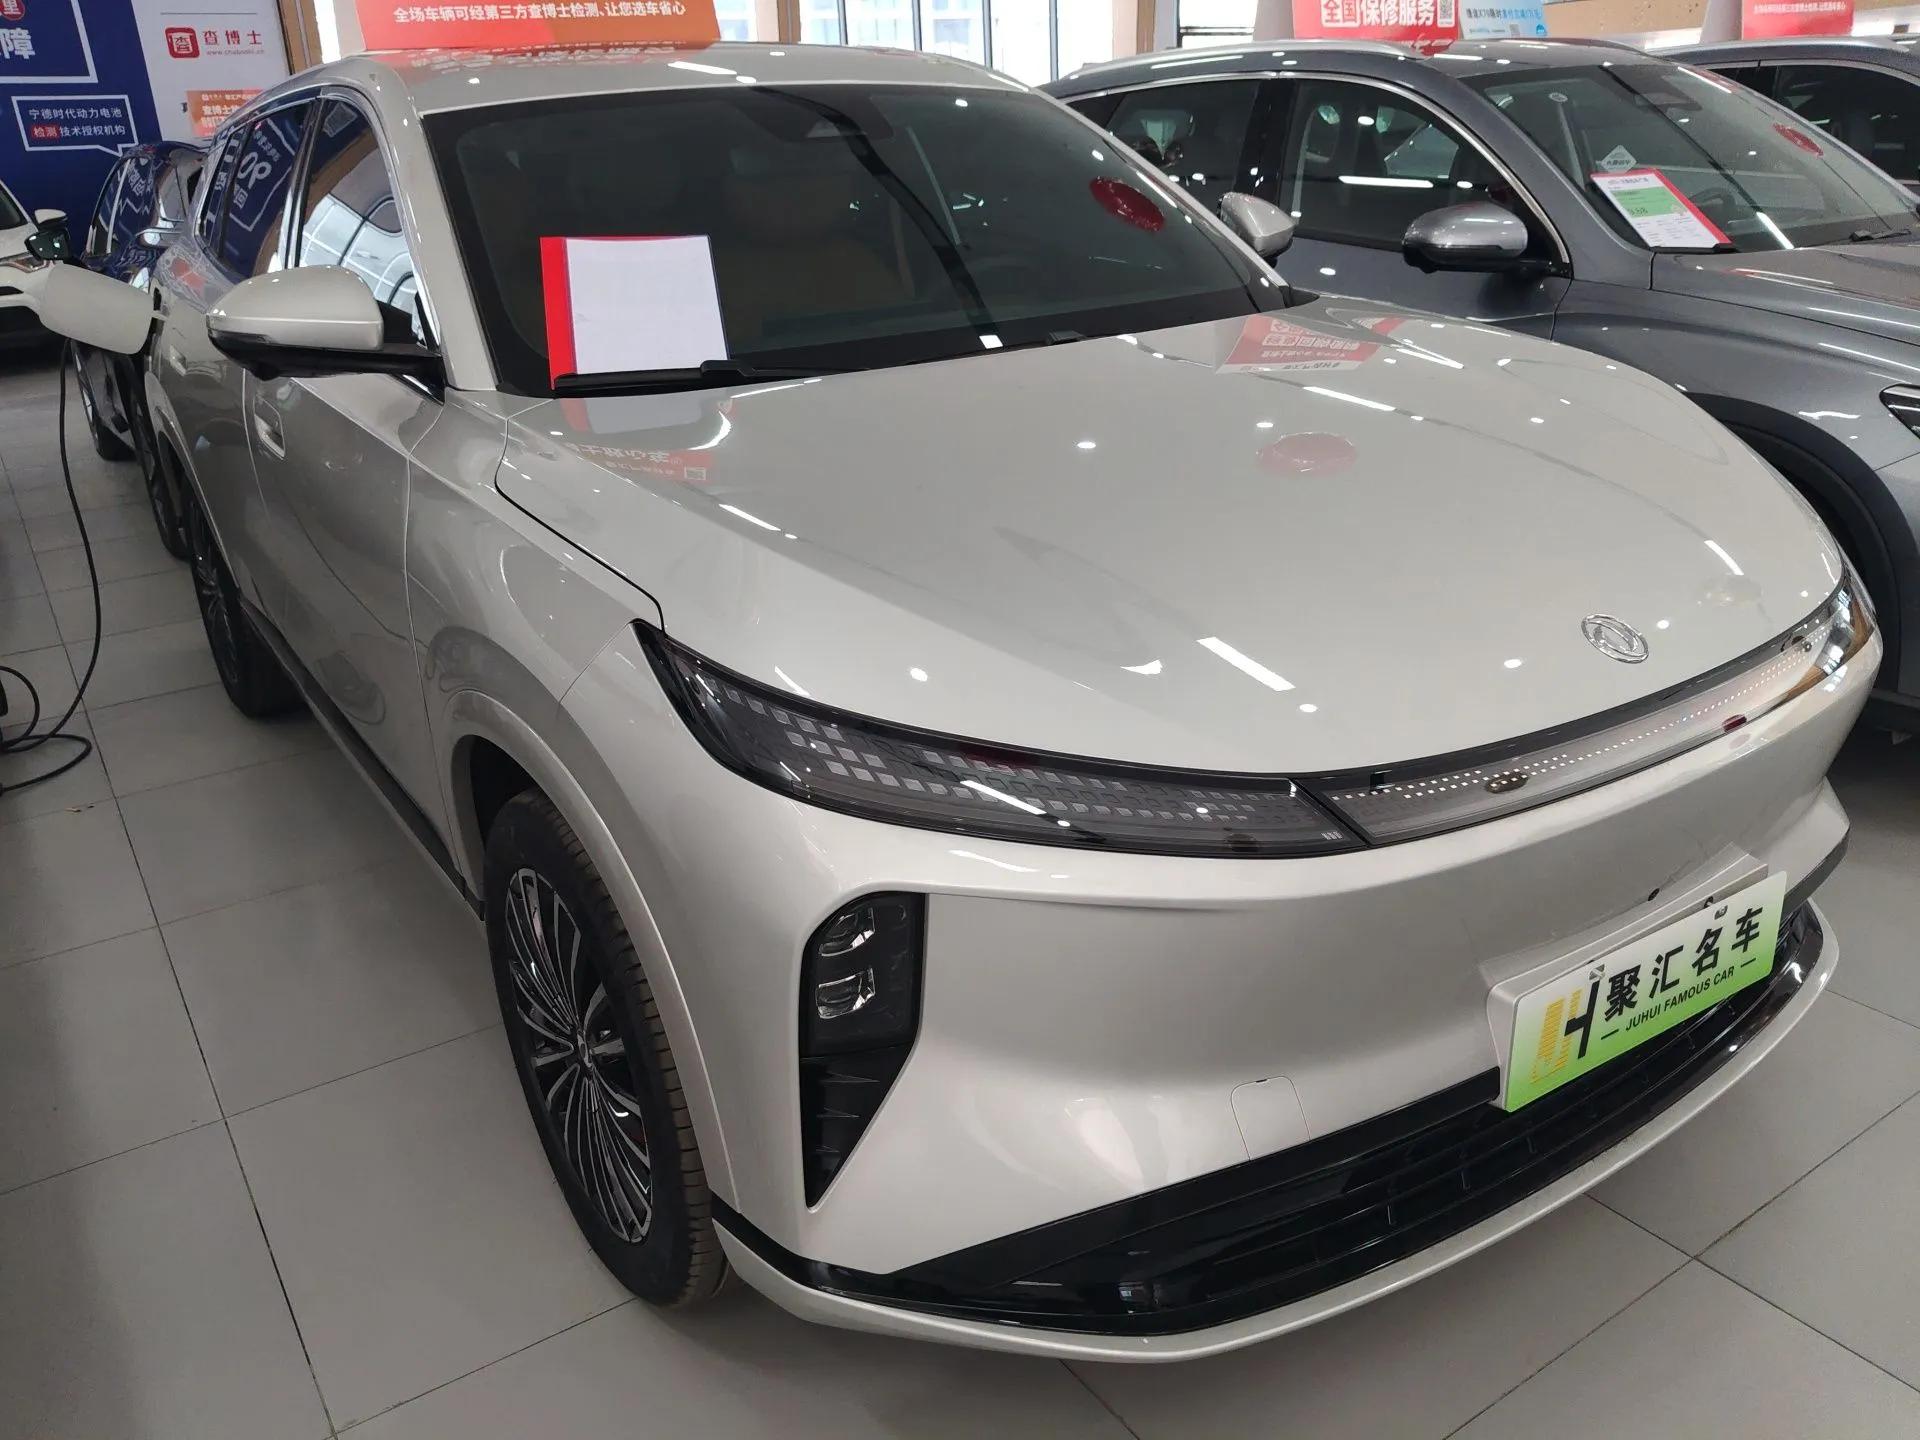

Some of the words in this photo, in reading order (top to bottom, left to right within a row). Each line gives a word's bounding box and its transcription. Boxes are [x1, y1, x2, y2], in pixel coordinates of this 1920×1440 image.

[1323, 0, 1436, 26] 全国保修服务
[203, 30, 263, 46] 查博士
[29, 107, 123, 119] 宁德时代动力电池
[33, 125, 127, 138] 检测技术授权机构
[1604, 906, 1764, 1022] 聚汇名车
[1626, 1003, 1661, 1032] JUHUI
[1664, 978, 1711, 1012] FAMOUS
[1713, 965, 1735, 985] CAR
